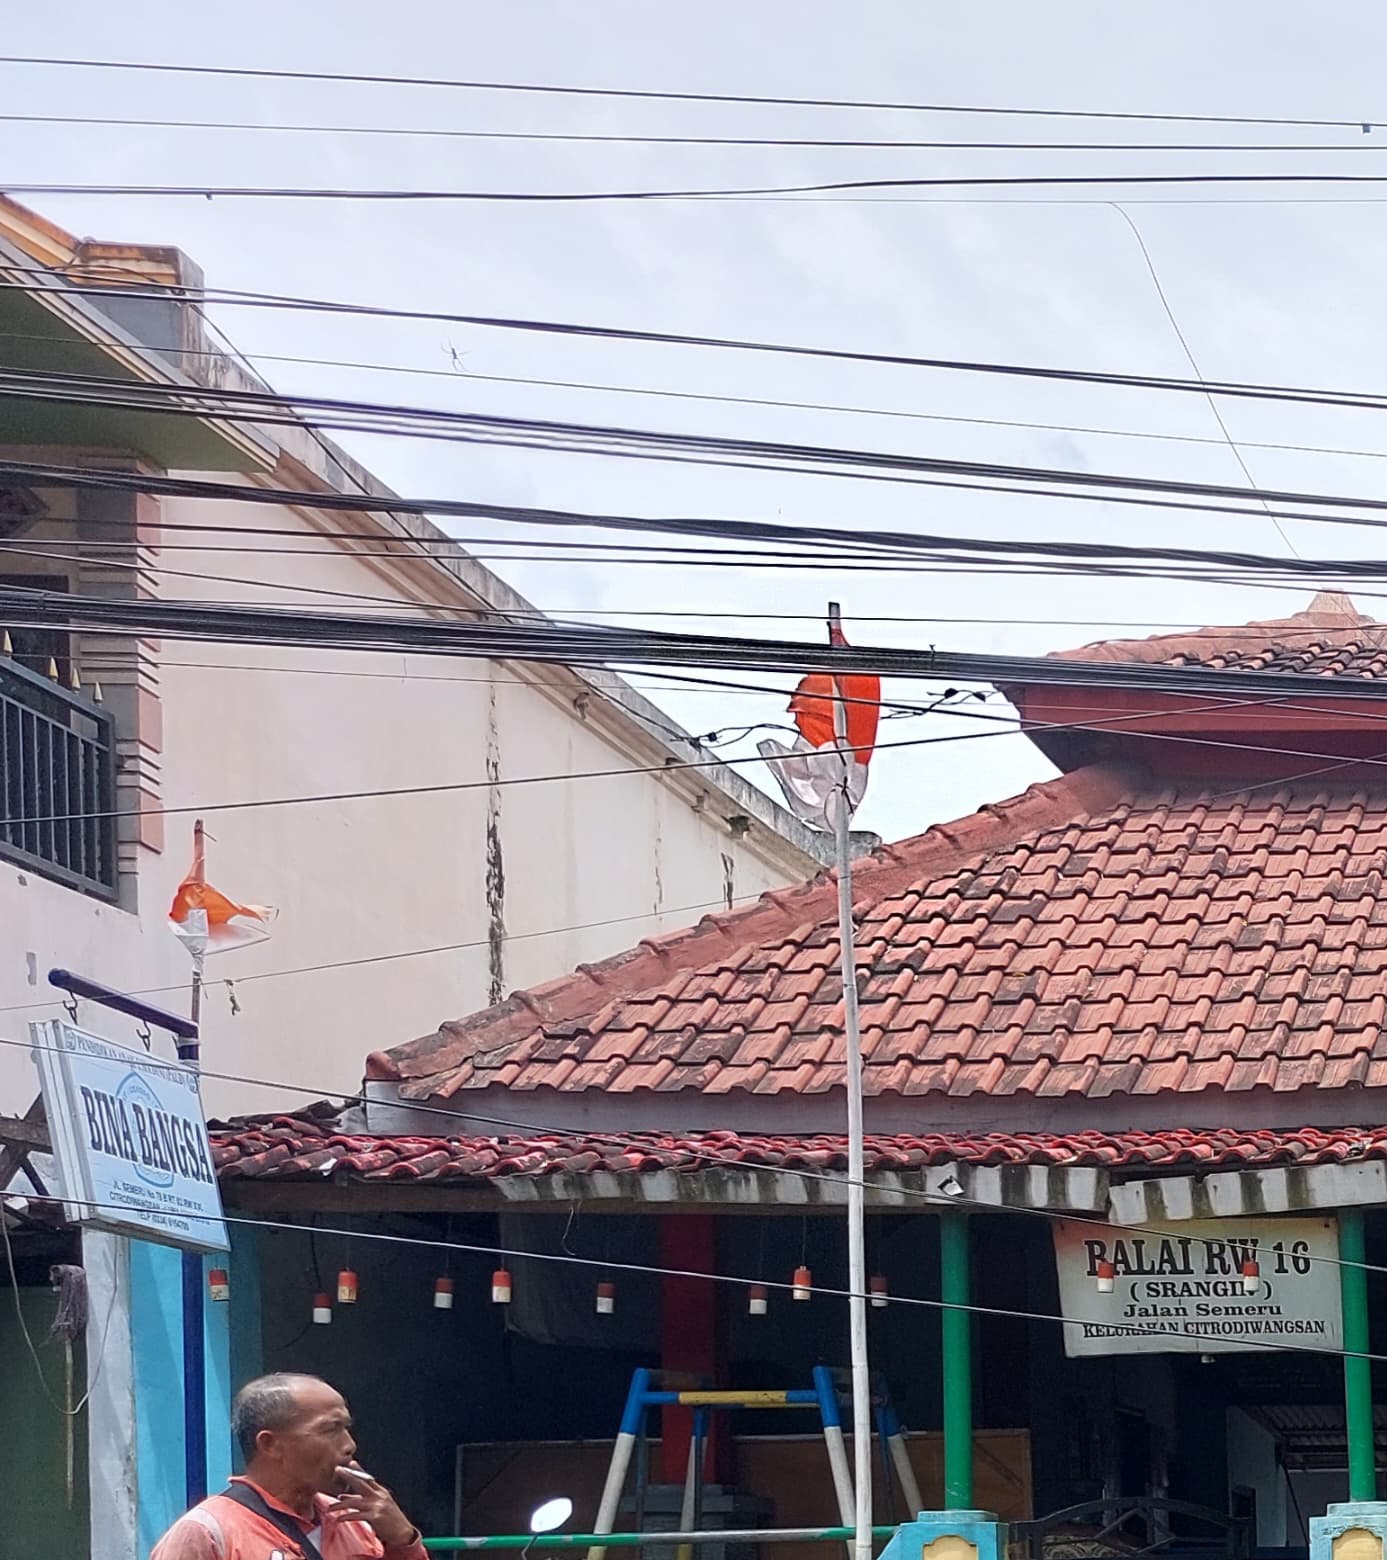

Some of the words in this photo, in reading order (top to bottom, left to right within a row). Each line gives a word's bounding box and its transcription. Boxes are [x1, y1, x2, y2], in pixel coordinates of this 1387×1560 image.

[80, 1085, 138, 1163] BINA
[132, 1102, 214, 1185] BANGSA
[1084, 1239, 1194, 1276] BALAI
[1204, 1238, 1259, 1275] RW
[1273, 1241, 1311, 1275] 16
[1124, 1304, 1188, 1318] Jalan
[1196, 1303, 1282, 1317] Semeru
[1184, 1320, 1325, 1335] CITRODIWANGSAN
